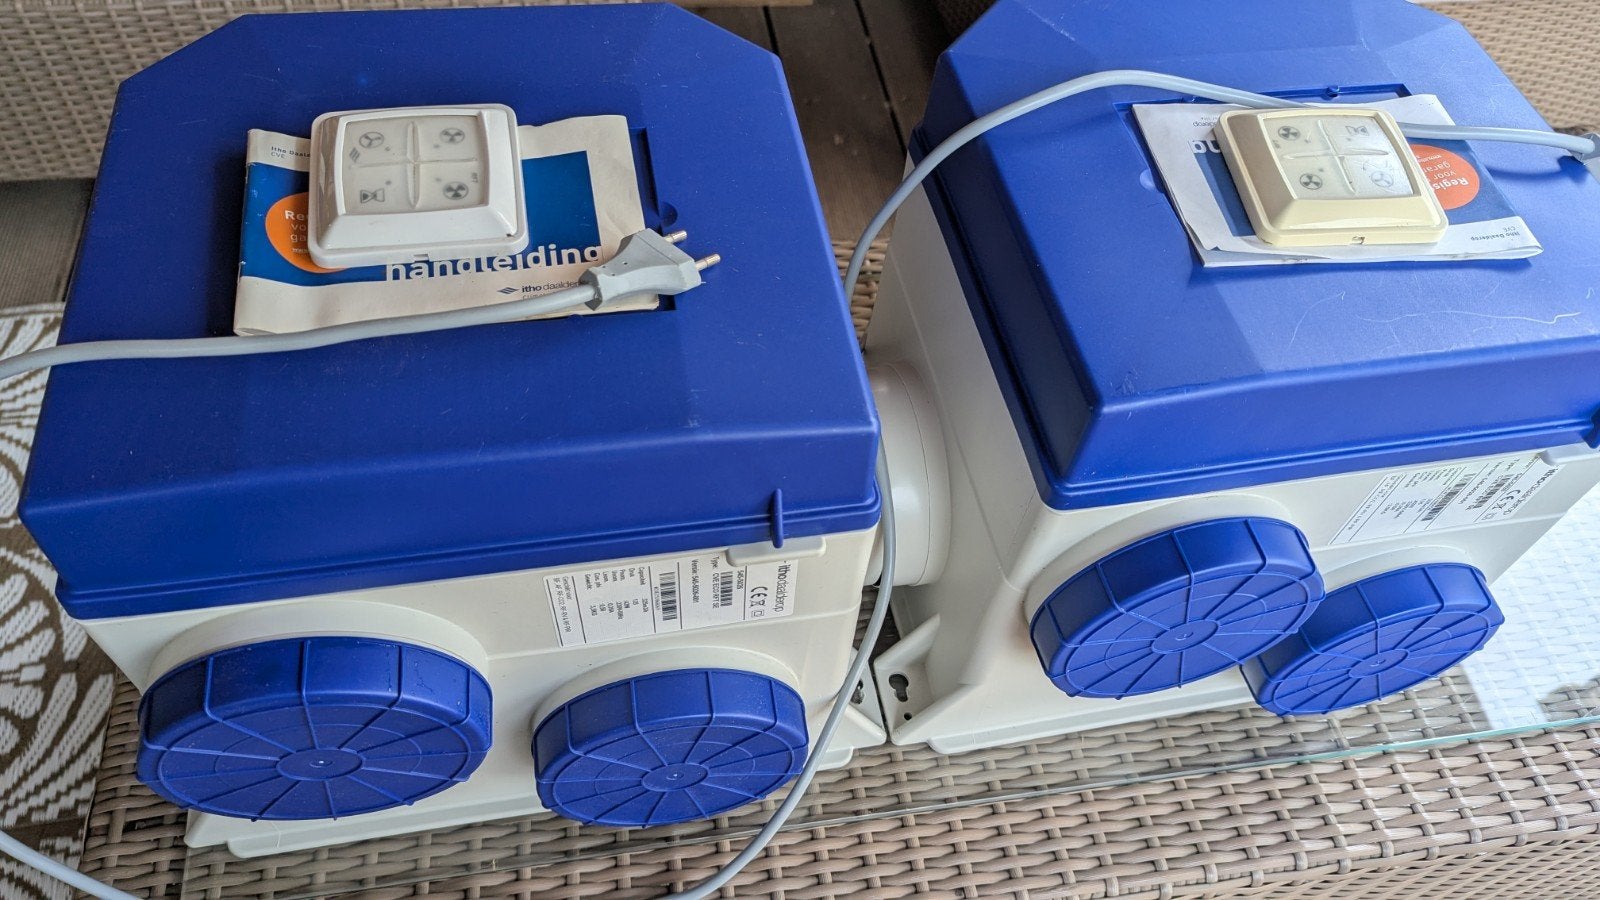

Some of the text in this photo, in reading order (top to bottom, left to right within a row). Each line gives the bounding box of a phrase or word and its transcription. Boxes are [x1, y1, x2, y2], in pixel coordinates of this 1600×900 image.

[271, 146, 311, 158] Itho Daald
[1423, 160, 1451, 173] gara
[1433, 170, 1457, 180] voor
[1432, 177, 1469, 190] Regis
[284, 210, 308, 221] Re
[290, 223, 307, 231] vo
[290, 234, 307, 243] ga
